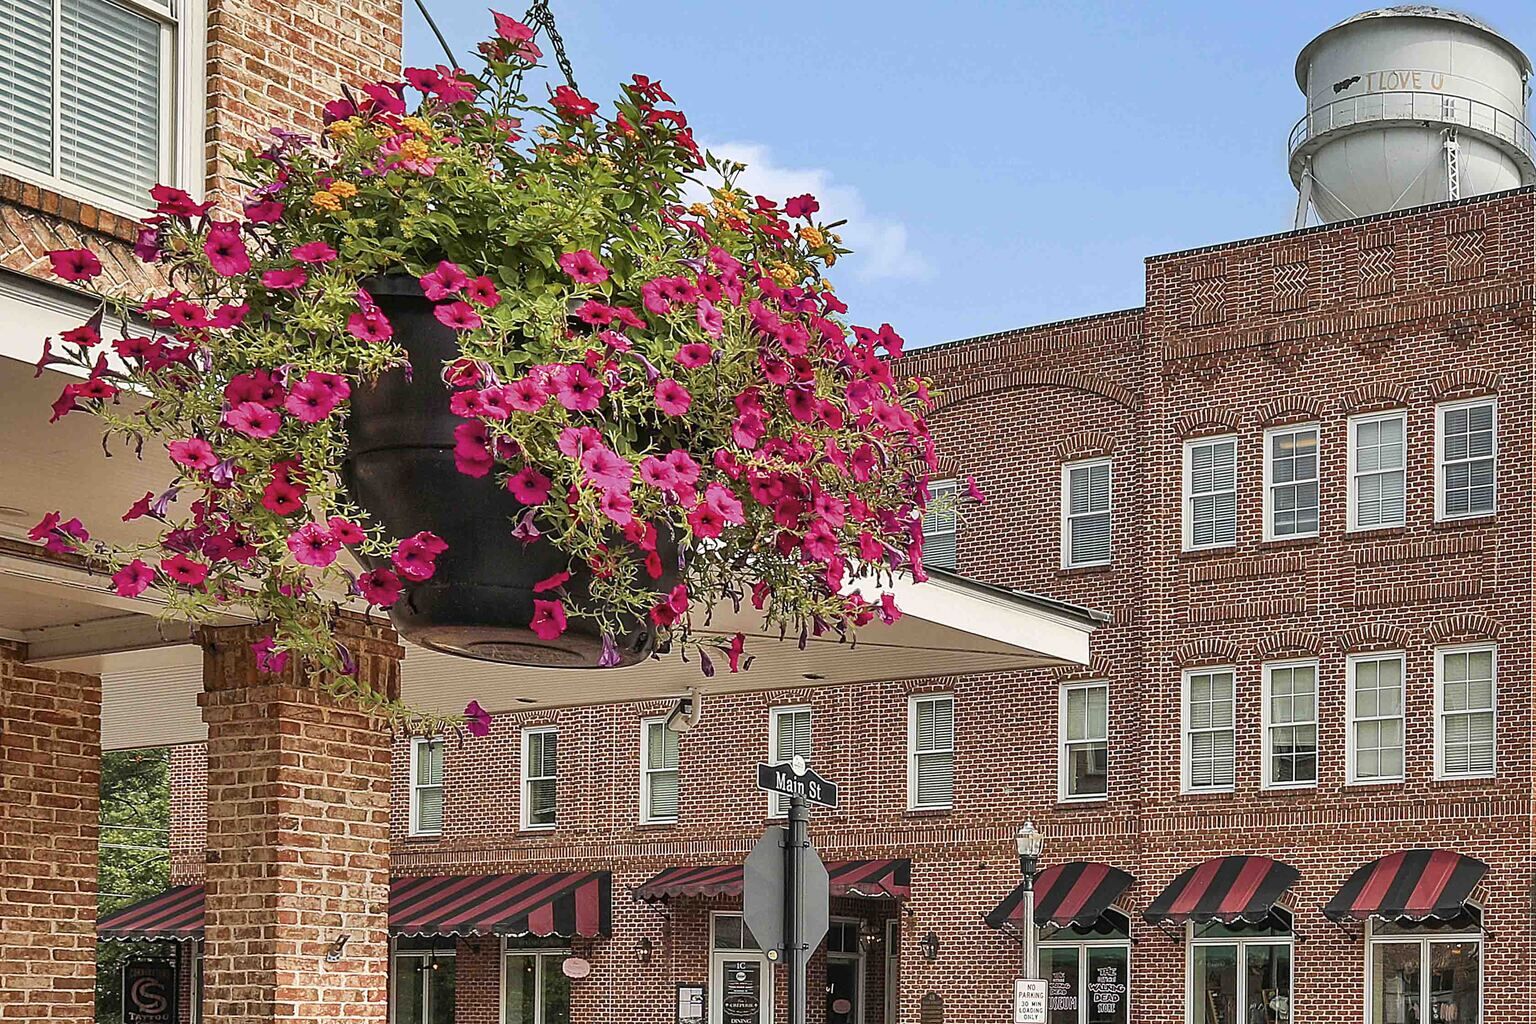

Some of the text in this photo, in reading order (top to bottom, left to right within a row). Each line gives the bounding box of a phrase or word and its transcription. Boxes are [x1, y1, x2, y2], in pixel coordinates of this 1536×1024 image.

[1379, 71, 1422, 90] LOVE
[1431, 73, 1444, 91] U
[775, 771, 821, 800] Main St
[1088, 983, 1126, 993] WALKING
[1048, 996, 1077, 1010] USEUM
[1094, 993, 1120, 1002] DEAD
[128, 1011, 169, 1020] TATTOO
